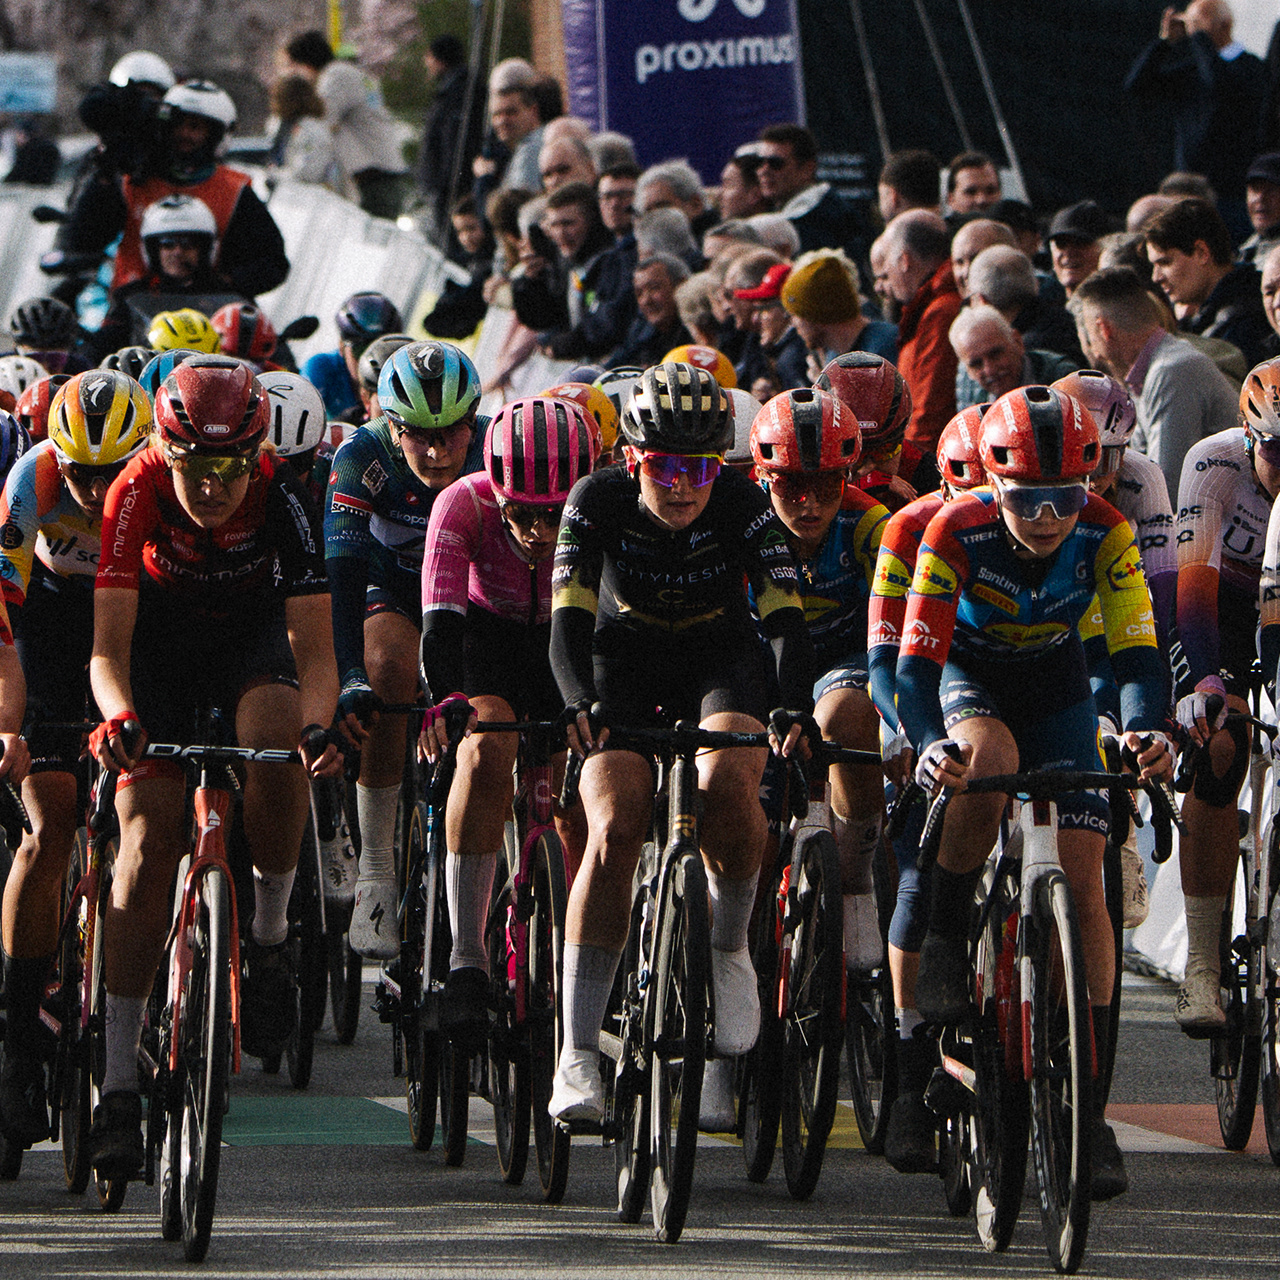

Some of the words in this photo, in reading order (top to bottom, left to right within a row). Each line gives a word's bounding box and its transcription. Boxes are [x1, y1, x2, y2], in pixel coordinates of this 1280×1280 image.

[635, 34, 796, 84] proximus
[1000, 397, 1018, 434] TREK
[113, 486, 141, 557] minimax
[744, 507, 776, 539] etixx
[961, 529, 999, 545] TREK
[978, 567, 1021, 596] Santini
